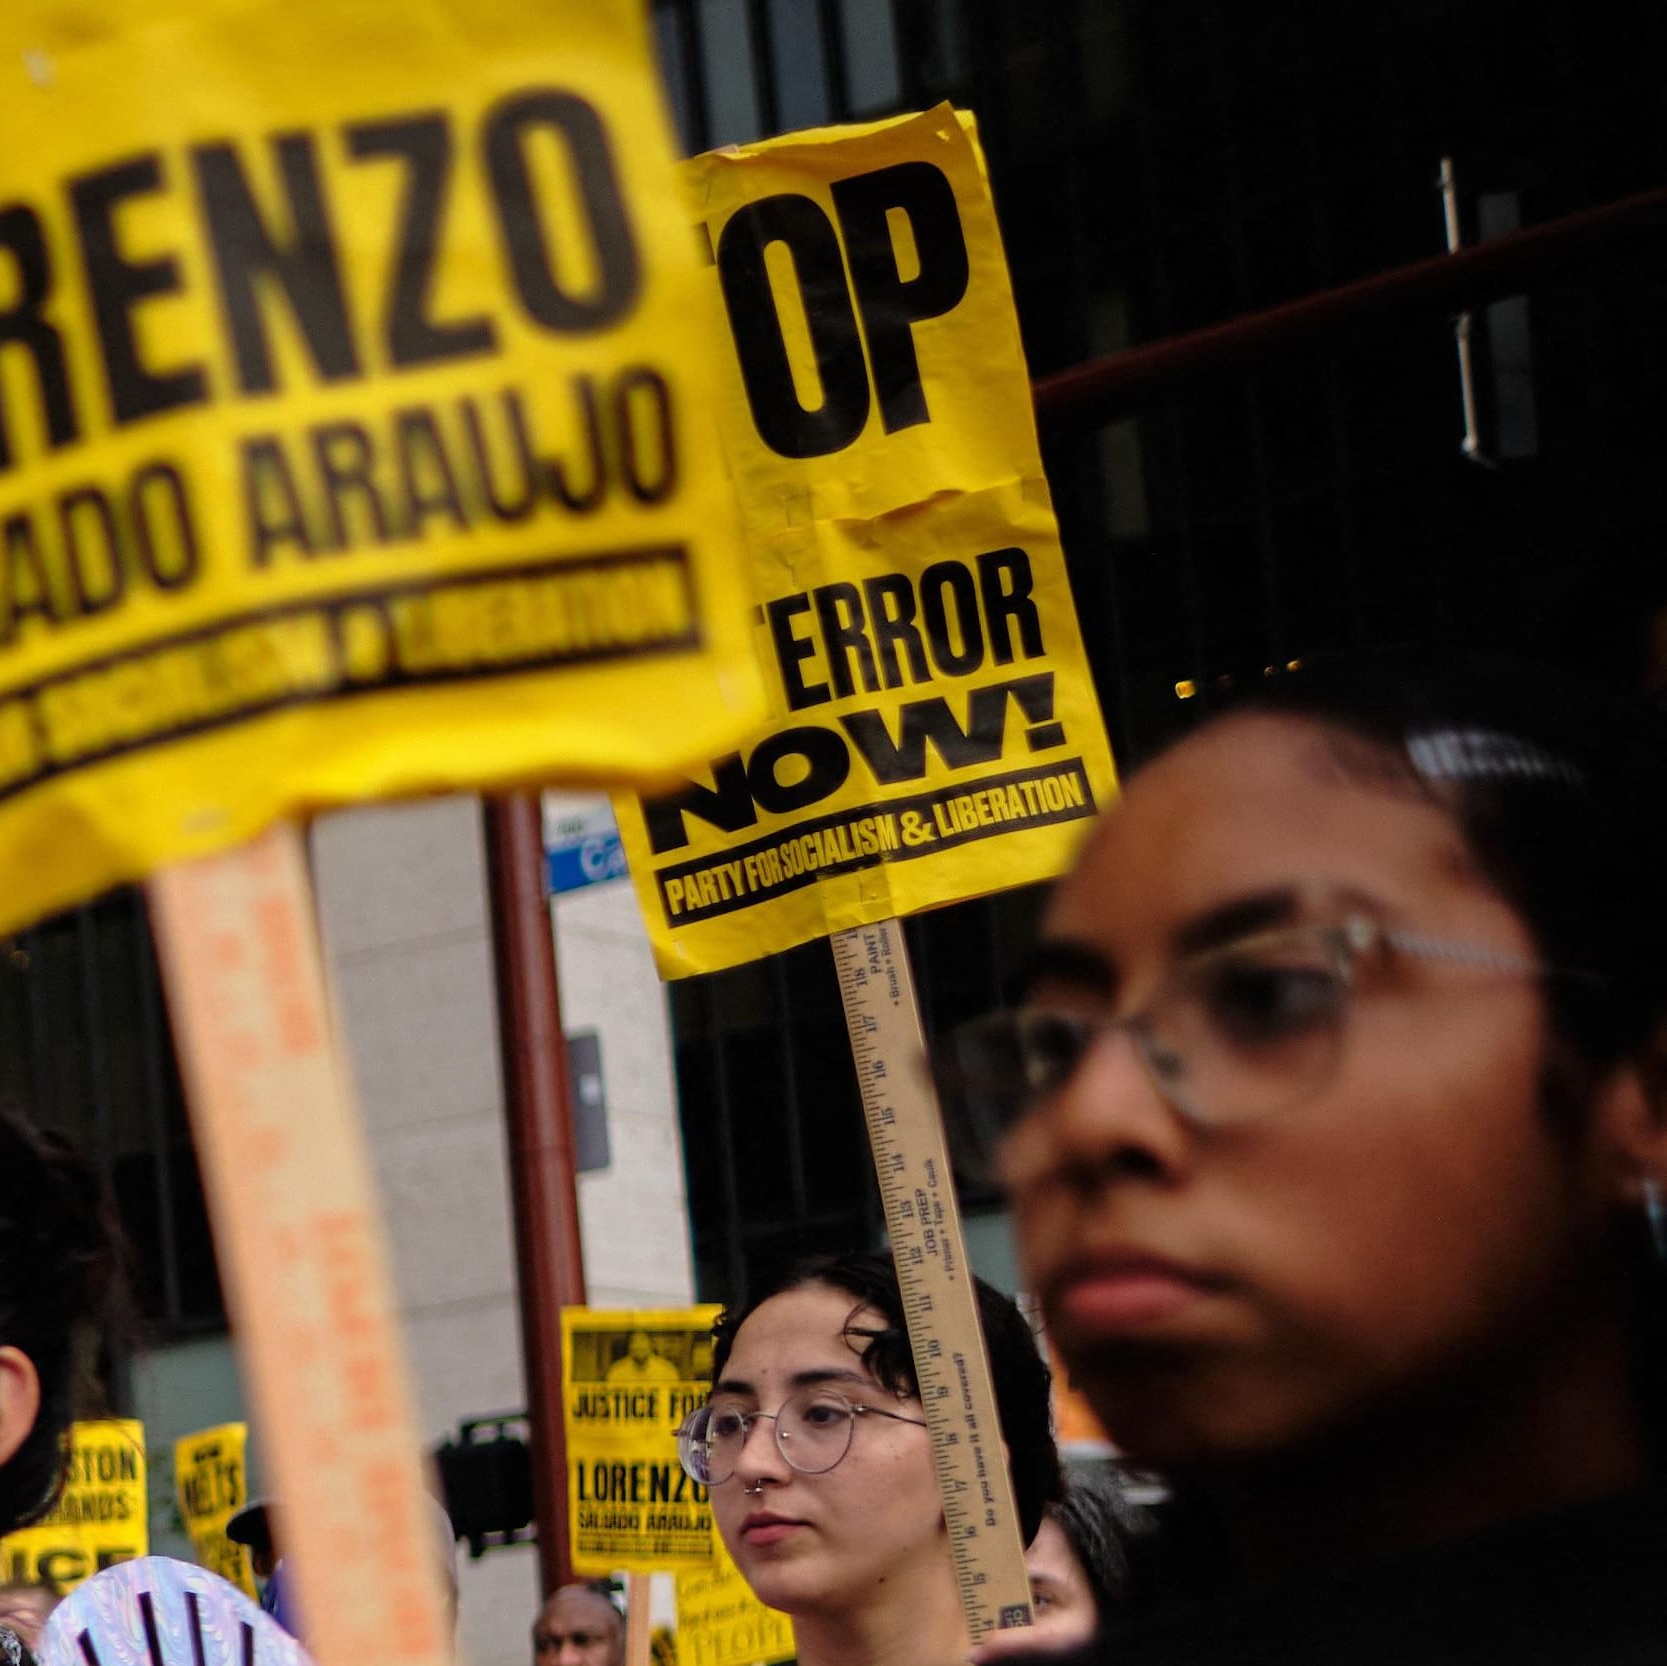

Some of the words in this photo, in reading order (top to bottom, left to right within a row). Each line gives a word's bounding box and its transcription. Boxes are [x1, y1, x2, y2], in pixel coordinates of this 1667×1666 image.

[699, 160, 970, 458] OP
[236, 363, 680, 574] ARAUJO
[753, 545, 1045, 713] ERROR
[642, 670, 1067, 855] NOW!
[664, 862, 747, 915] PARTY
[747, 848, 783, 893] FOR
[780, 812, 899, 882] SOCIALISM
[901, 808, 937, 848] &
[931, 772, 1085, 839] LIBERATION
[862, 932, 882, 974] PAINT
[913, 1186, 932, 1225] PREP
[922, 1228, 938, 1257] JOB
[572, 1391, 659, 1420] JUSTICE
